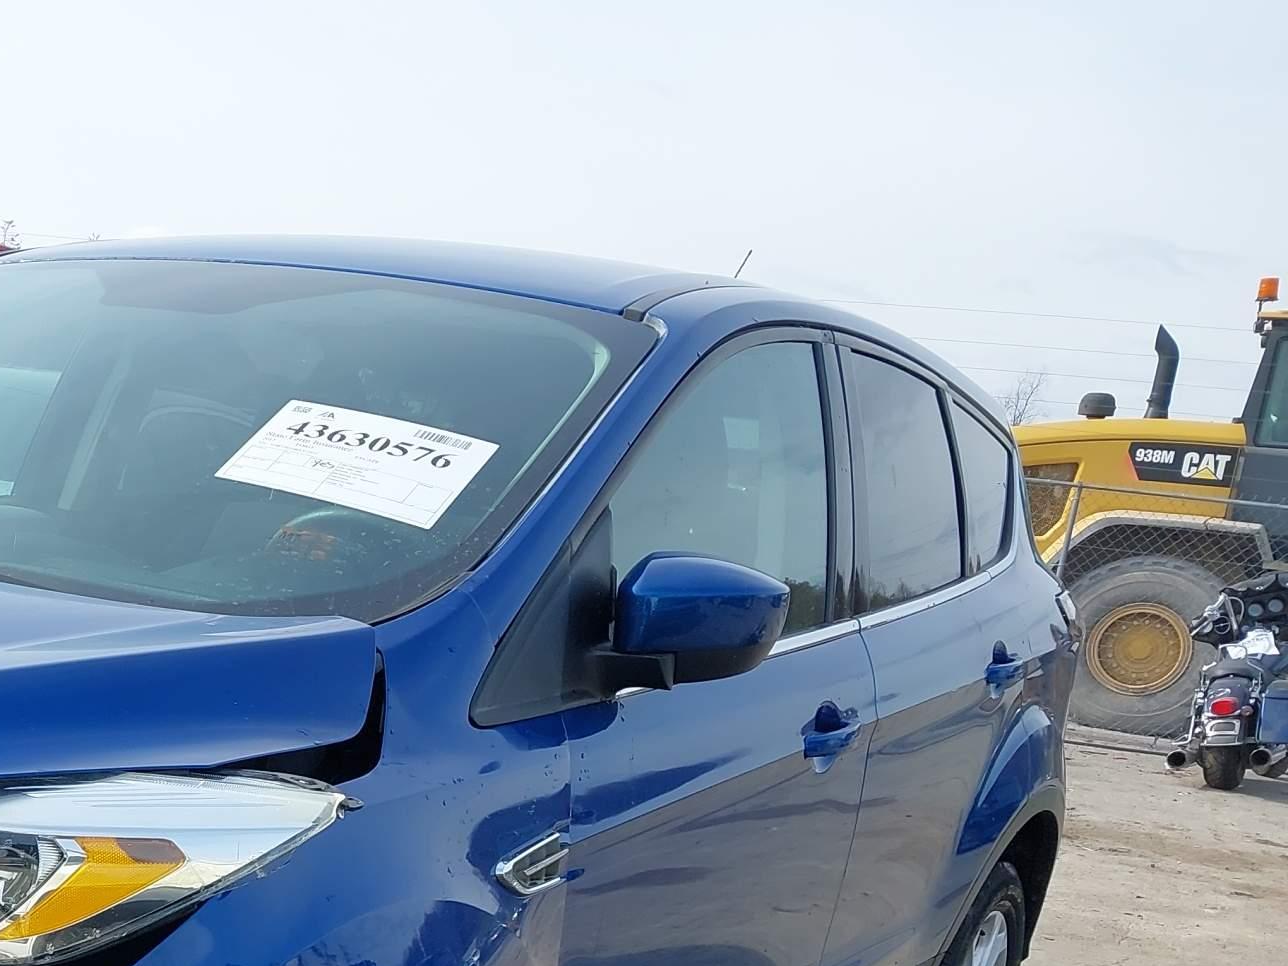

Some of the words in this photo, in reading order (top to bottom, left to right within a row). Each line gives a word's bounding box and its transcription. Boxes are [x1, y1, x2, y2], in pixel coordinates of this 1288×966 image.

[286, 421, 458, 468] 43630576
[1135, 448, 1175, 464] 938M
[1181, 452, 1231, 480] CAT
